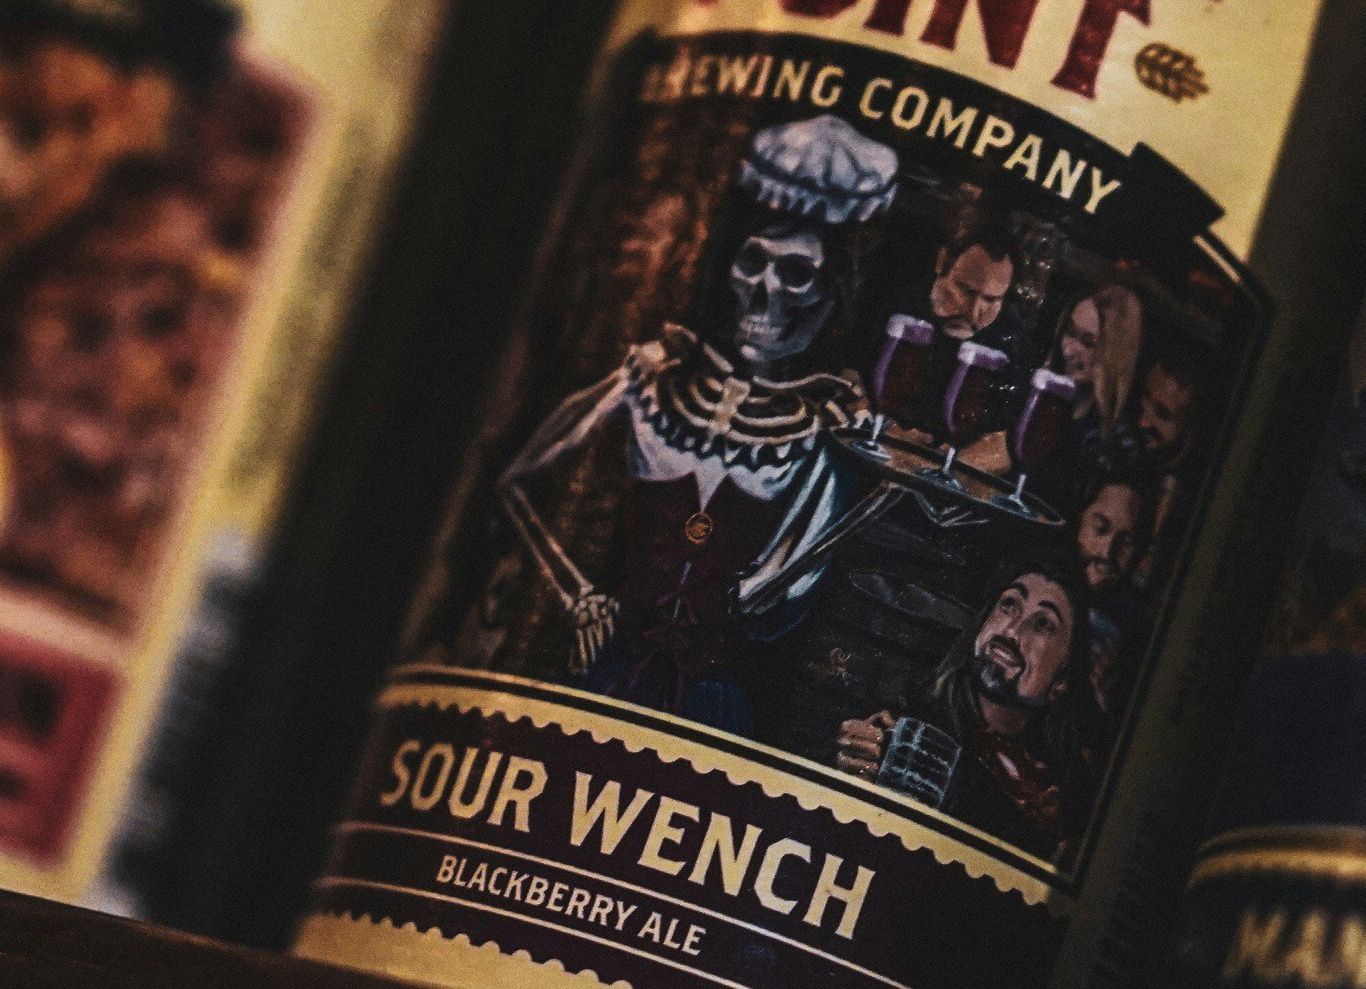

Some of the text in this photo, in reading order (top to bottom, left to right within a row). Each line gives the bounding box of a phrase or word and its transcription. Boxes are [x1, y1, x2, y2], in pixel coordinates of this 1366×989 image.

[638, 46, 1123, 215] BREWING COMPANY
[378, 738, 877, 941] SOUR WENCH
[436, 854, 708, 957] BLACKBERRY ALE
